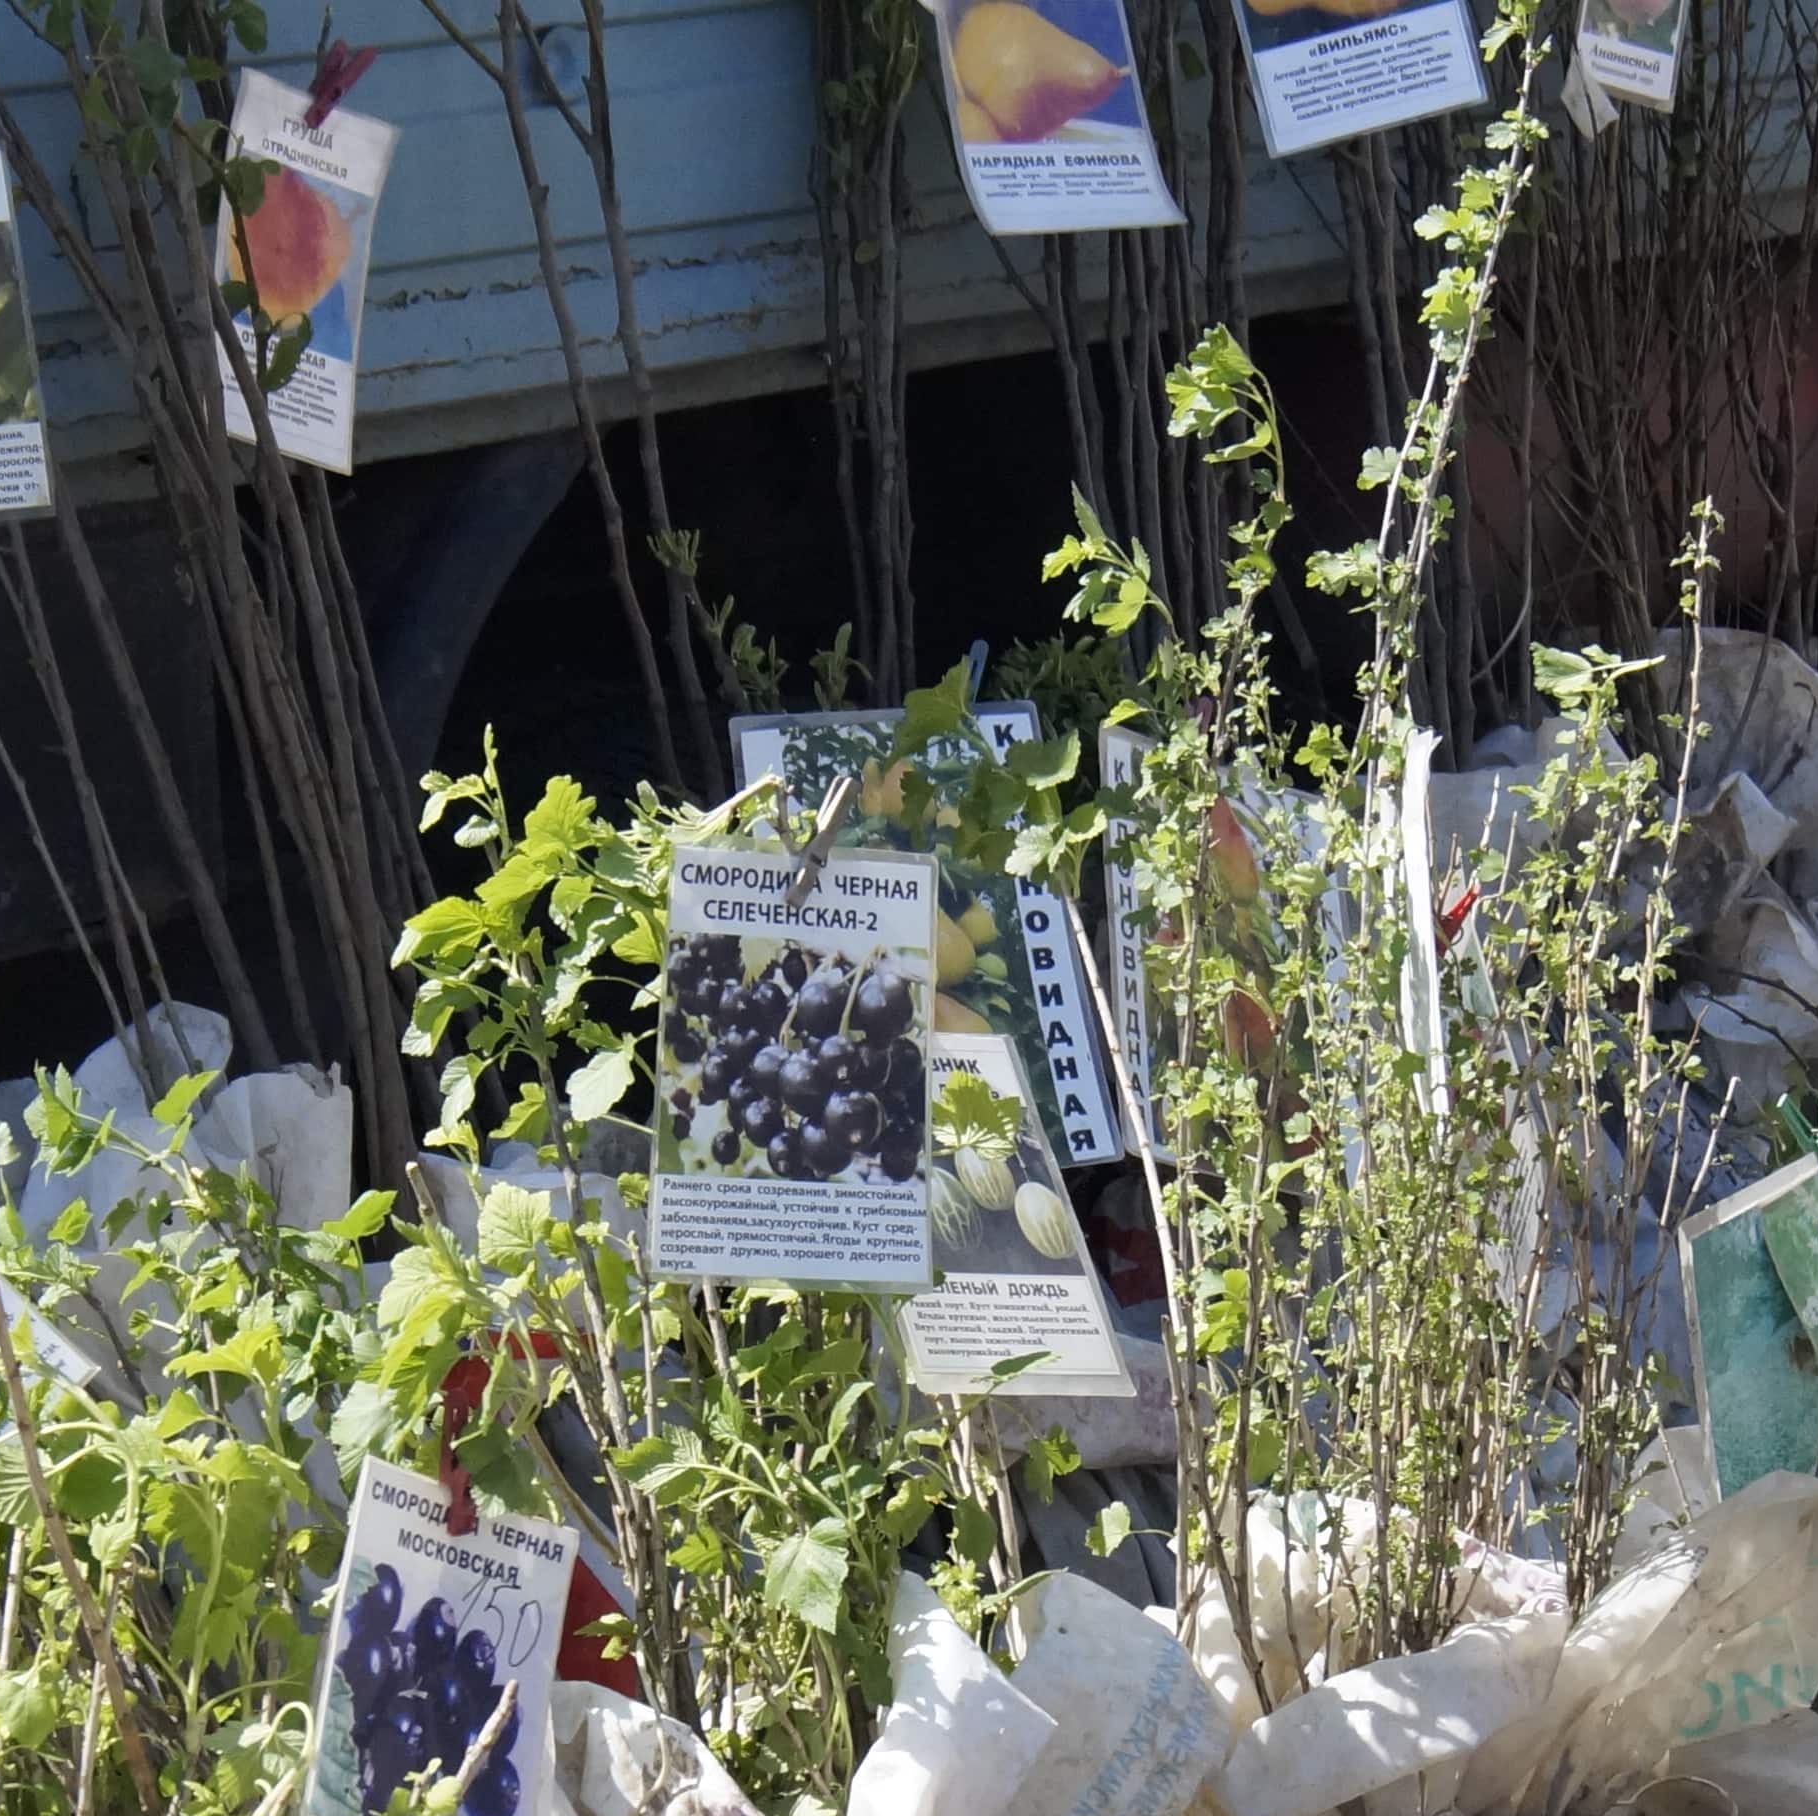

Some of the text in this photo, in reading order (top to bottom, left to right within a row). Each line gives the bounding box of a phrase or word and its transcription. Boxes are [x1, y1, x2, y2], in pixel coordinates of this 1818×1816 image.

[1309, 24, 1408, 58] «ВИЛЬЯМС»
[283, 117, 334, 152] ГРУША
[262, 138, 348, 180] ОТРАДНЕНСКАЯ
[971, 153, 1142, 170] НАРЯДНАЯ ЕФИМОВА
[681, 863, 918, 900] СМОРОДИА ЧЕРНАЯ
[704, 900, 878, 931] СЕЛЕЧЕНСКАЯ-2
[663, 1178, 917, 1203] Раннего срока созревания, зимостойкий,
[662, 1197, 927, 1217] высокоурожайный, устойчив к грибковым
[661, 1229, 724, 1241] нерослый,
[822, 1233, 861, 1246] Ягоды
[867, 1238, 923, 1249] крупные,
[853, 1220, 879, 1234] Куст
[884, 1223, 918, 1235] сред-
[659, 1259, 697, 1271] вкуса.
[660, 1243, 921, 1263] созревают дружно, хорошего десертного
[1008, 1283, 1069, 1299] ДОЖДЬ
[397, 1528, 520, 1584] МОСКОВСКАЯ
[492, 1521, 565, 1563] ЧЕРНАЯ
[457, 1576, 542, 1667] 150
